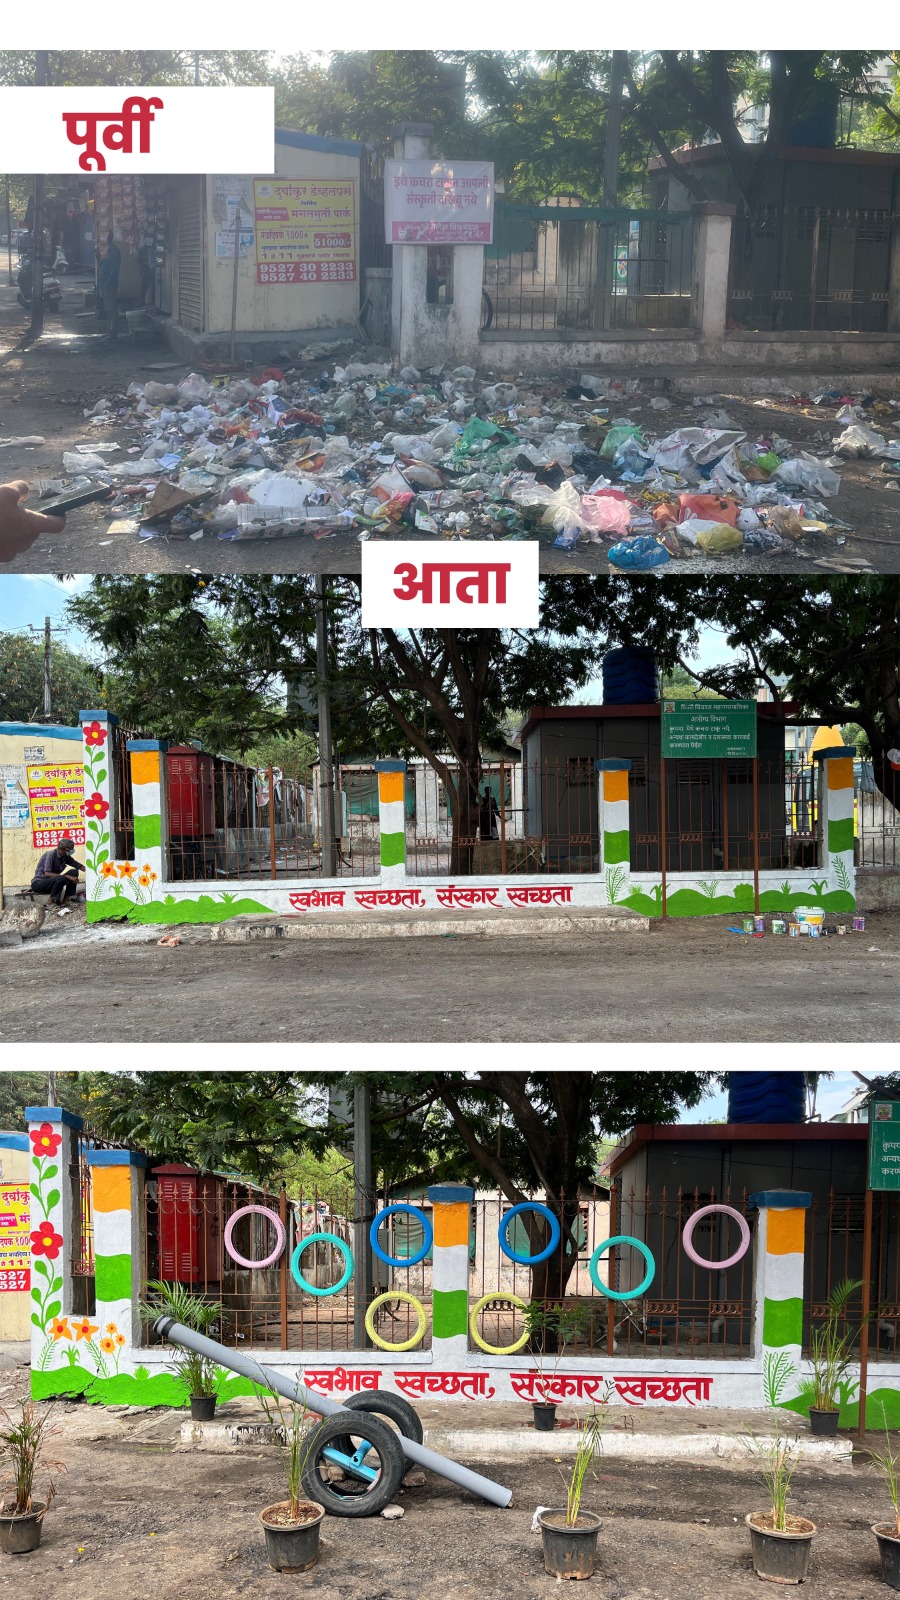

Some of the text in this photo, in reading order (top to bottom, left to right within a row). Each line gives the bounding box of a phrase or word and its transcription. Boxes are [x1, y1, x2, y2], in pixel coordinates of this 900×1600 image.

[394, 173, 408, 188] इथे
[410, 177, 433, 187] कचरा
[461, 175, 488, 188] आपली
[406, 191, 436, 208] संस्कृती
[464, 192, 477, 205] नये
[334, 208, 351, 217] पार्क
[314, 238, 350, 247] 51000/-
[260, 264, 295, 272] 9527
[320, 262, 353, 271] 2233
[260, 272, 296, 282] 9527
[321, 271, 353, 280] 2233
[36, 831, 64, 839] 9527
[36, 838, 60, 847] 952
[288, 886, 573, 911] स्वभाव स्वच्छता, संस्कार स्वच्छता
[304, 1367, 713, 1405] स्वभाव स्वच्छता, संस्कार स्वच्छता
